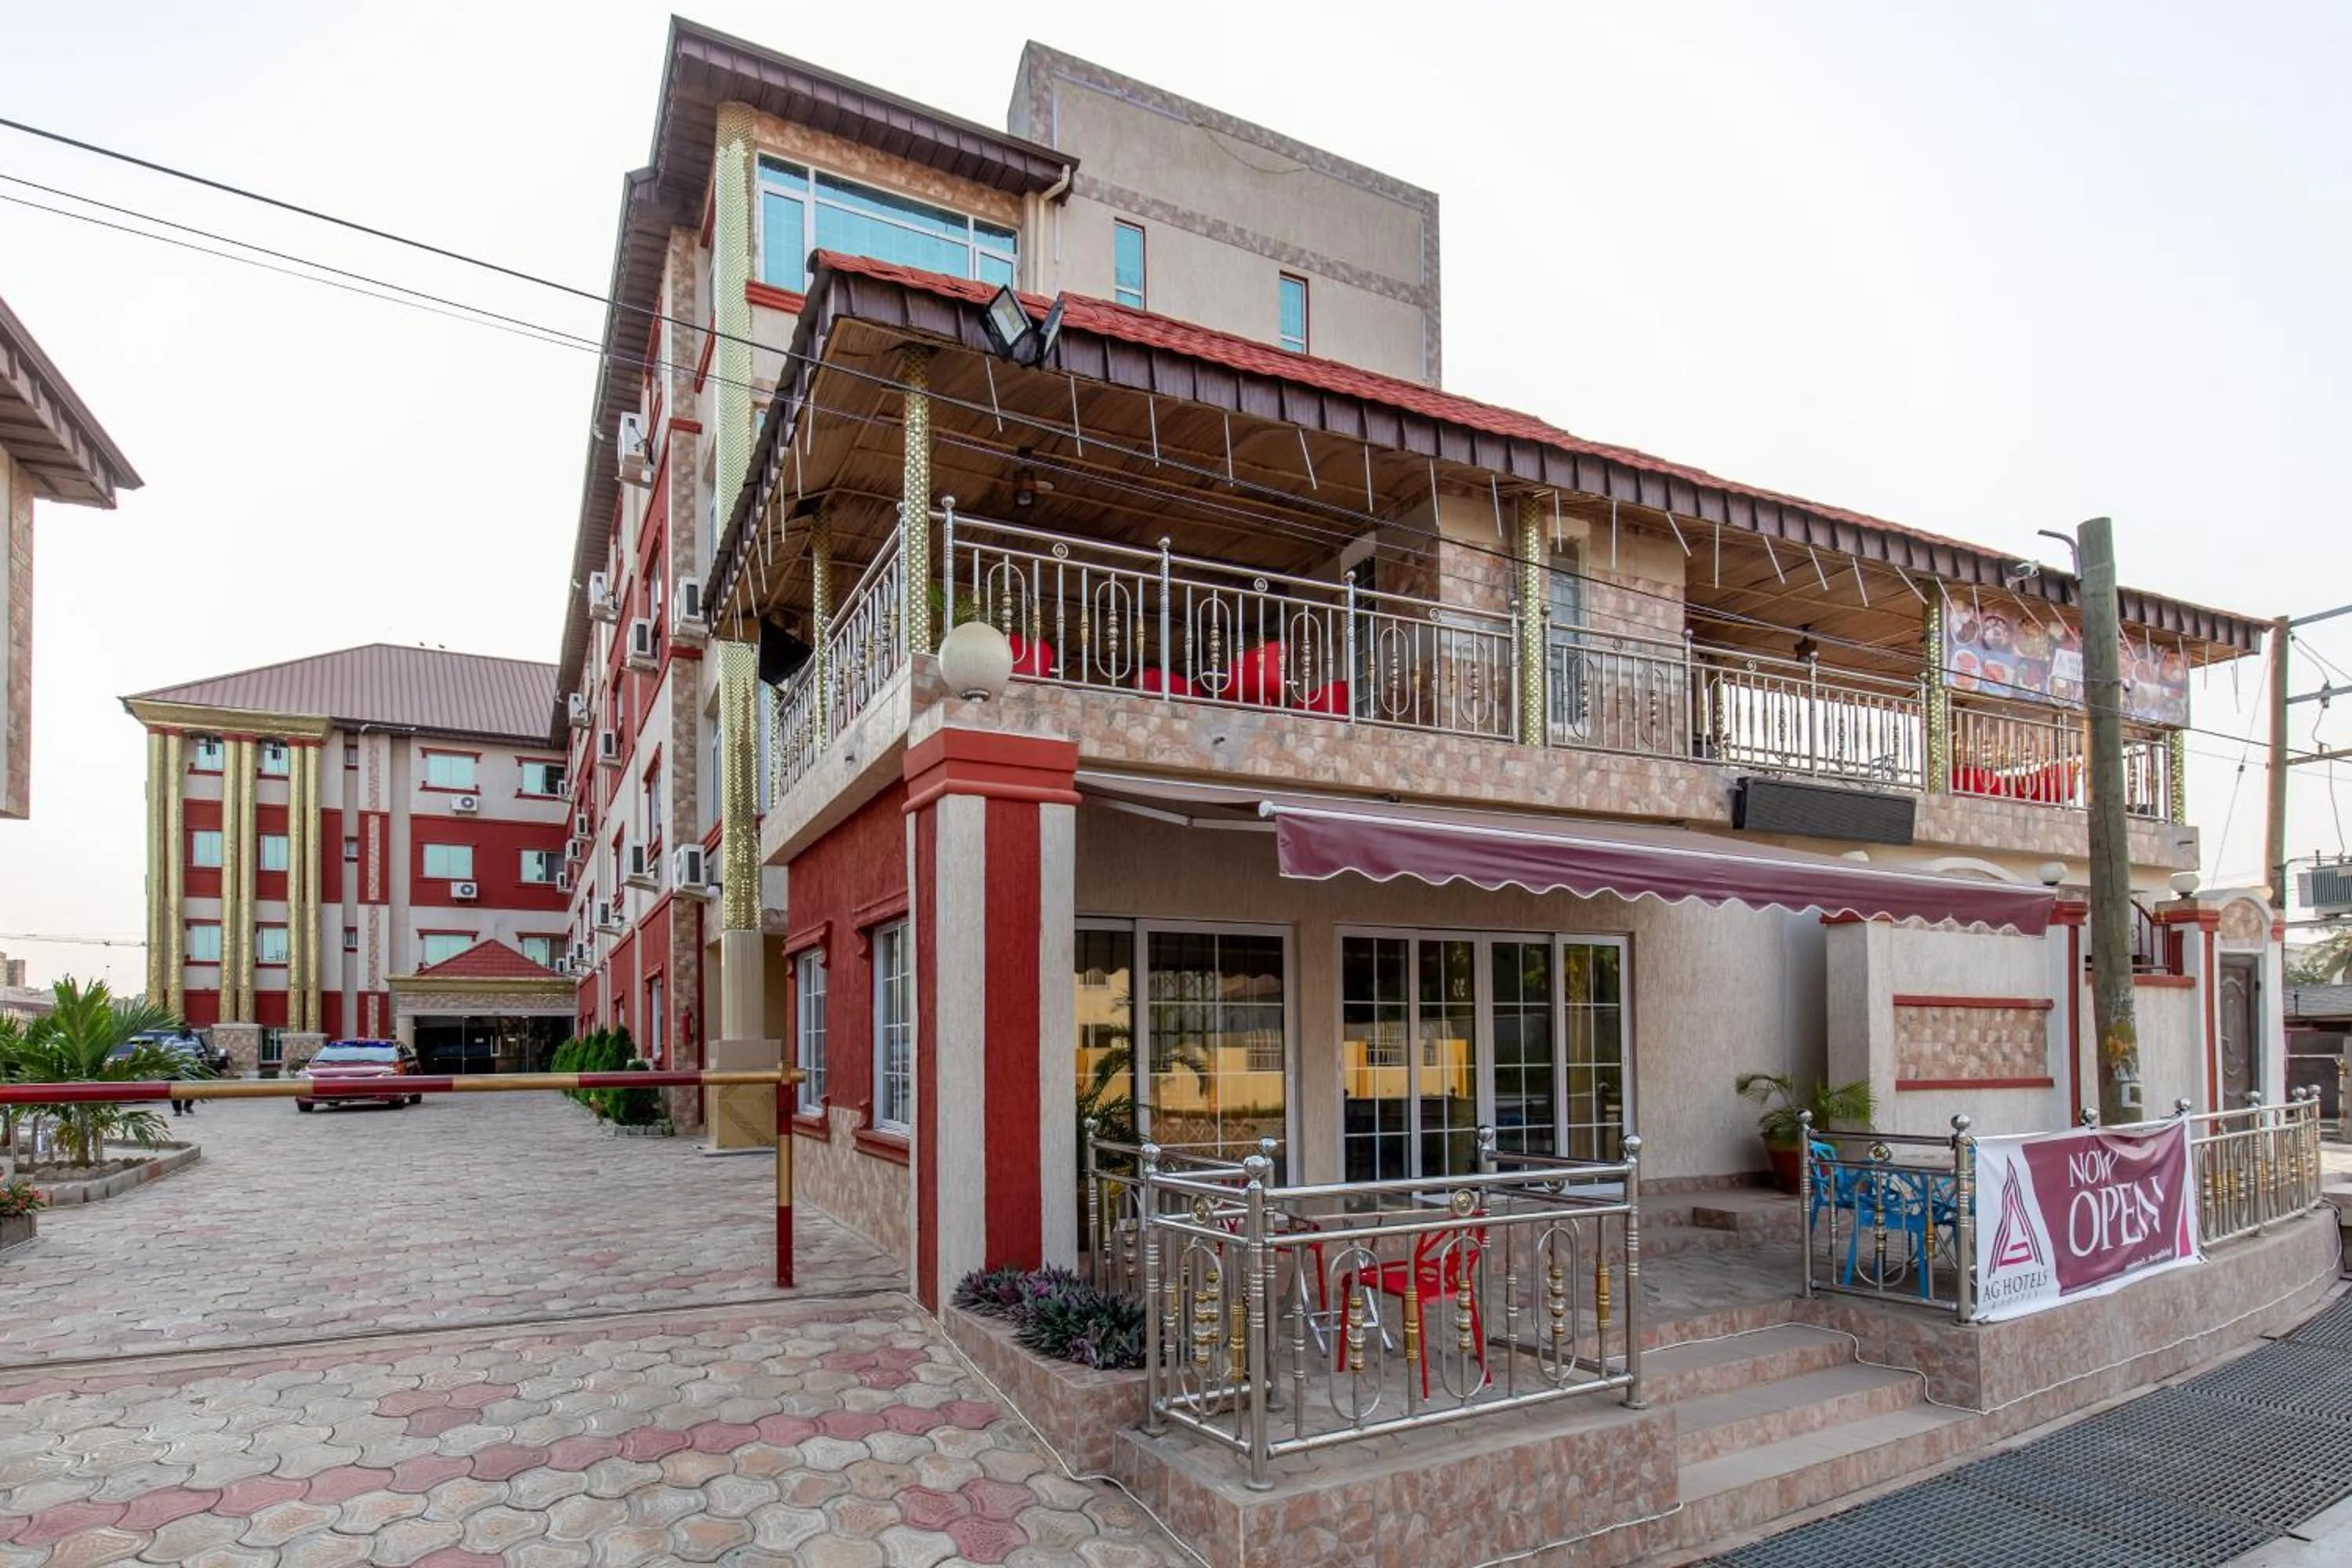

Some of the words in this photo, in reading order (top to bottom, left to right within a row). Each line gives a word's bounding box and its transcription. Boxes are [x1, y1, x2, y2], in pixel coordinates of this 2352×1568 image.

[2069, 1149, 2119, 1188] NOW
[2069, 1176, 2165, 1257] OPEN
[1982, 1280, 2000, 1302] AG
[2003, 1271, 2047, 1296] HOTELS
